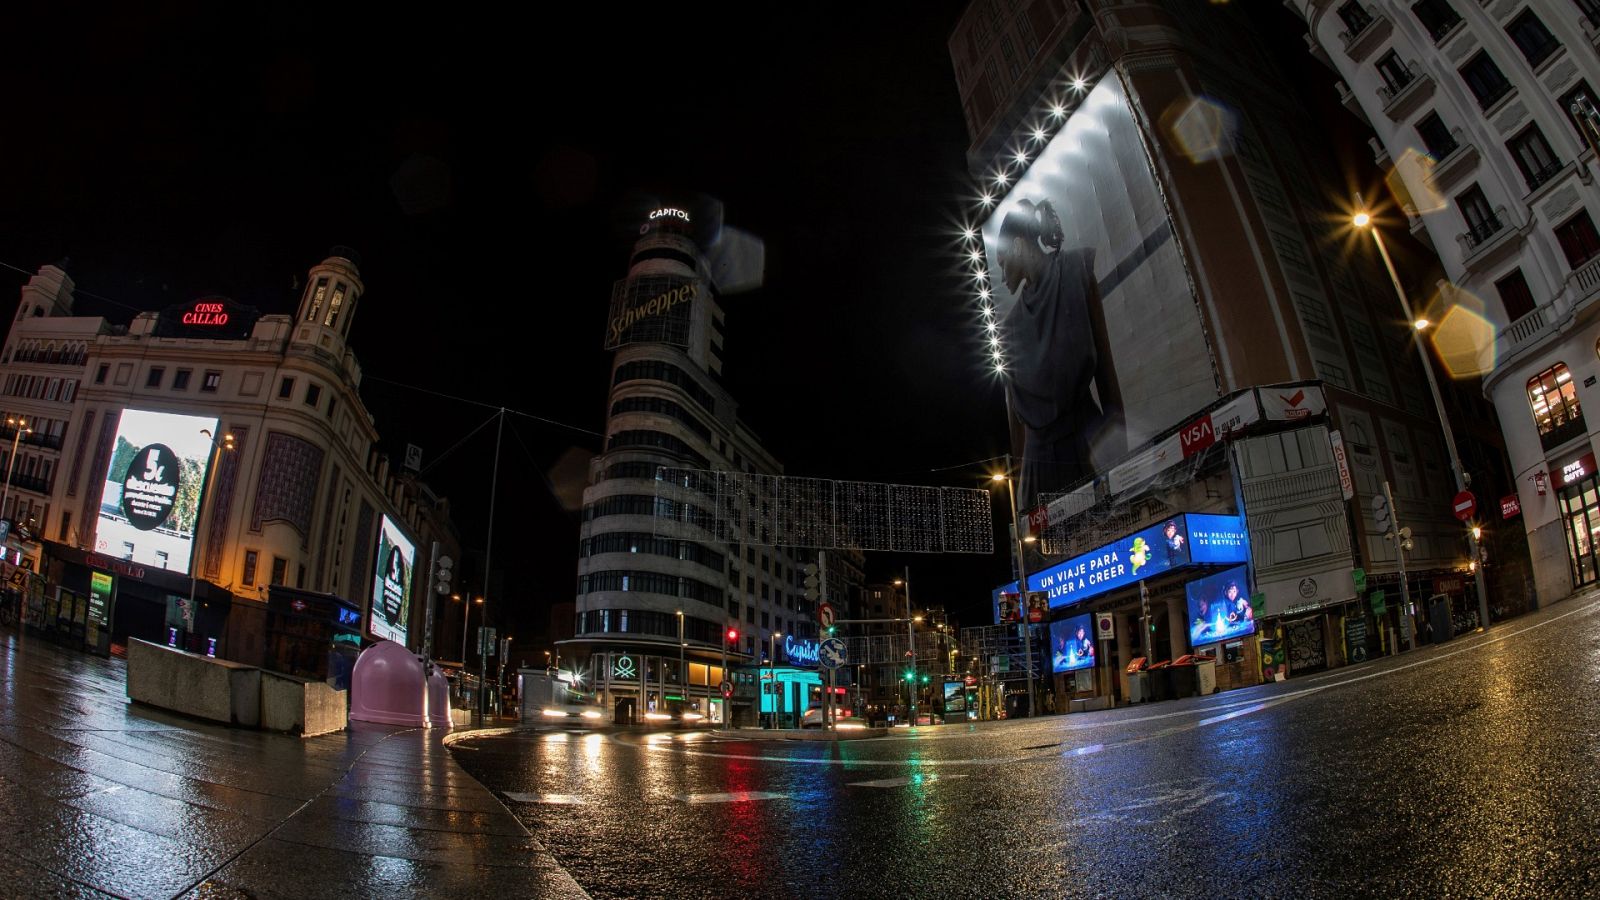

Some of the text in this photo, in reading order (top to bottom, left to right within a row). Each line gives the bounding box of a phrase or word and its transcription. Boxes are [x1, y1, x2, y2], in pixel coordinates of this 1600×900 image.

[650, 208, 690, 222] CAPITOL
[195, 303, 224, 313] CINES
[610, 283, 697, 341] Schweppes
[183, 312, 229, 325] CALLAO
[1182, 421, 1212, 447] VSA
[1563, 460, 1581, 475] FIVE
[1563, 467, 1585, 483] GUYS
[1193, 531, 1208, 539] UNA
[1212, 539, 1241, 547] NETFLIX
[1041, 551, 1118, 589] UN VIAJE PARA
[1078, 577, 1086, 590] A
[1089, 564, 1125, 585] CREER
[786, 635, 820, 662] Capitol
